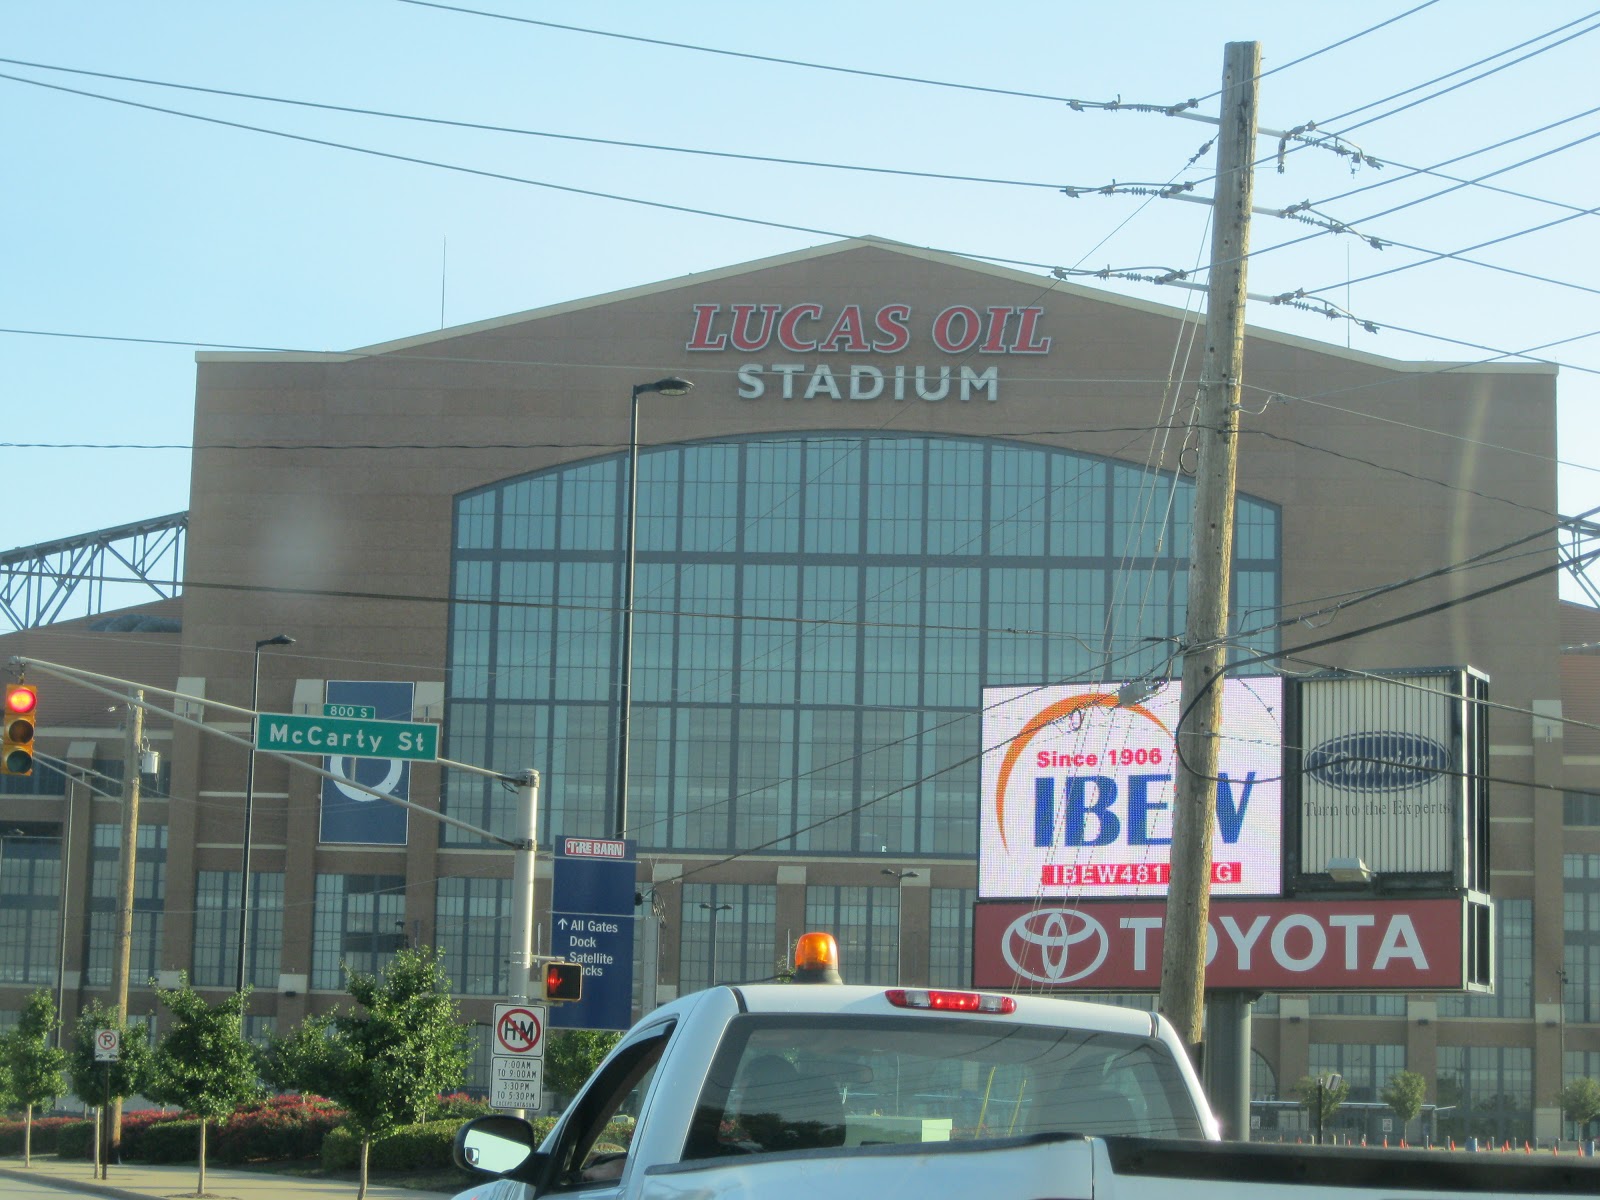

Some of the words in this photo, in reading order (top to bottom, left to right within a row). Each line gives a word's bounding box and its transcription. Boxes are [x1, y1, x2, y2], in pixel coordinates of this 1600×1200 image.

[685, 304, 911, 353] LUCAS
[931, 305, 1051, 354] OIL
[737, 363, 998, 401] STADIUM
[330, 705, 354, 717] 800
[360, 707, 368, 718] S
[269, 723, 382, 753] McCarty
[397, 731, 424, 751] St
[1036, 750, 1098, 768] Since
[1108, 748, 1163, 766] 1906
[1326, 750, 1434, 776] Carrier
[1305, 802, 1339, 817] Turn
[1345, 803, 1359, 816] to
[1366, 801, 1387, 816] the
[593, 843, 622, 856] BARN
[1053, 862, 1232, 883] IBEW481G
[570, 919, 584, 931] All
[587, 920, 618, 933] Gates
[569, 935, 596, 948] Dock
[1119, 914, 1430, 972] TYOTA
[569, 951, 613, 965] Satellite
[504, 1020, 534, 1041] HM
[503, 1060, 531, 1069] 7:00AM
[498, 1069, 506, 1077] TO
[509, 1070, 537, 1078] 9:00AM
[503, 1082, 530, 1091] 3:30PM
[497, 1091, 505, 1100] TO
[508, 1092, 535, 1101] 5:30PM
